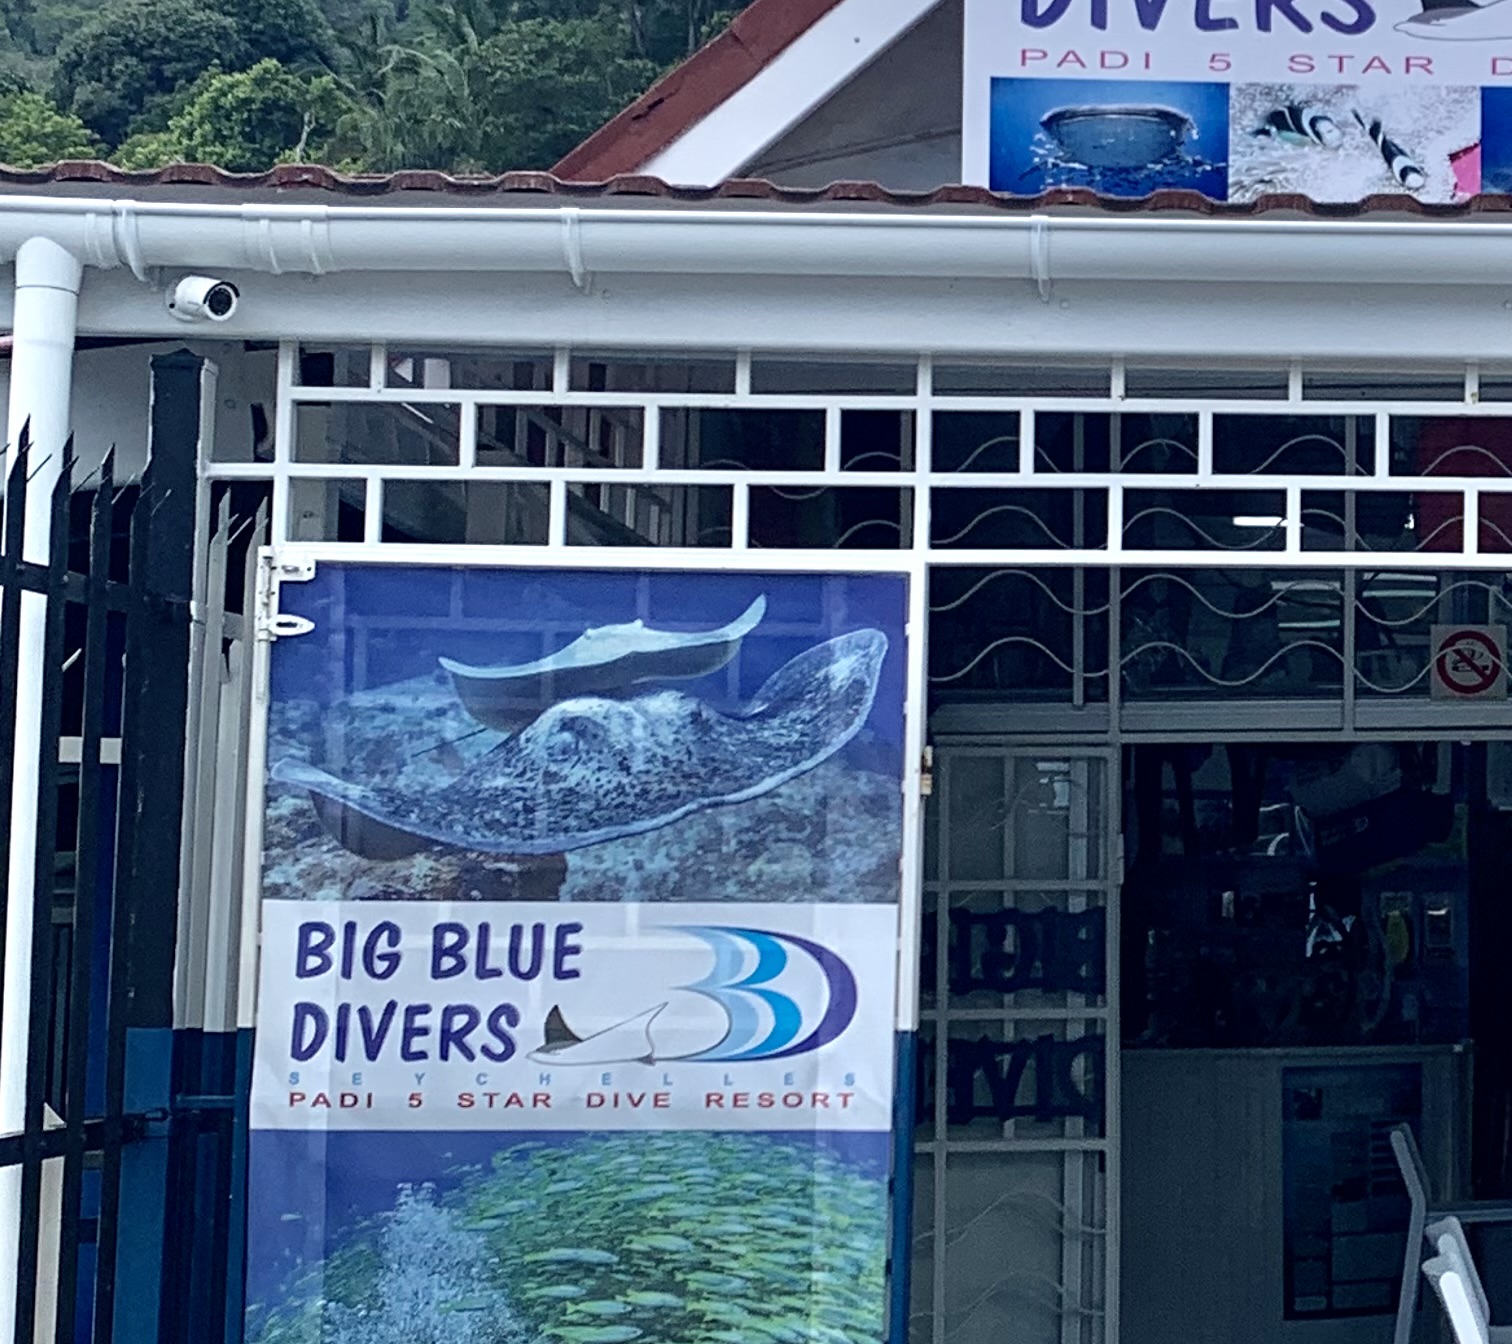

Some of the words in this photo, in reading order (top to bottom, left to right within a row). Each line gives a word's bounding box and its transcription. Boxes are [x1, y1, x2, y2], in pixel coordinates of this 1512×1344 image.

[1020, 49, 1152, 70] PADI
[1208, 54, 1232, 72] 5
[1287, 55, 1433, 74] STAR
[295, 920, 402, 980] BIG
[431, 921, 583, 980] BLUE
[290, 999, 521, 1063] DIVERS
[288, 1071, 856, 1086] SEYCHELLES
[288, 1092, 373, 1108] PADI
[408, 1092, 423, 1108] 5
[457, 1092, 552, 1108] STAR
[586, 1092, 671, 1108] DIVE
[704, 1092, 855, 1108] RESORT
